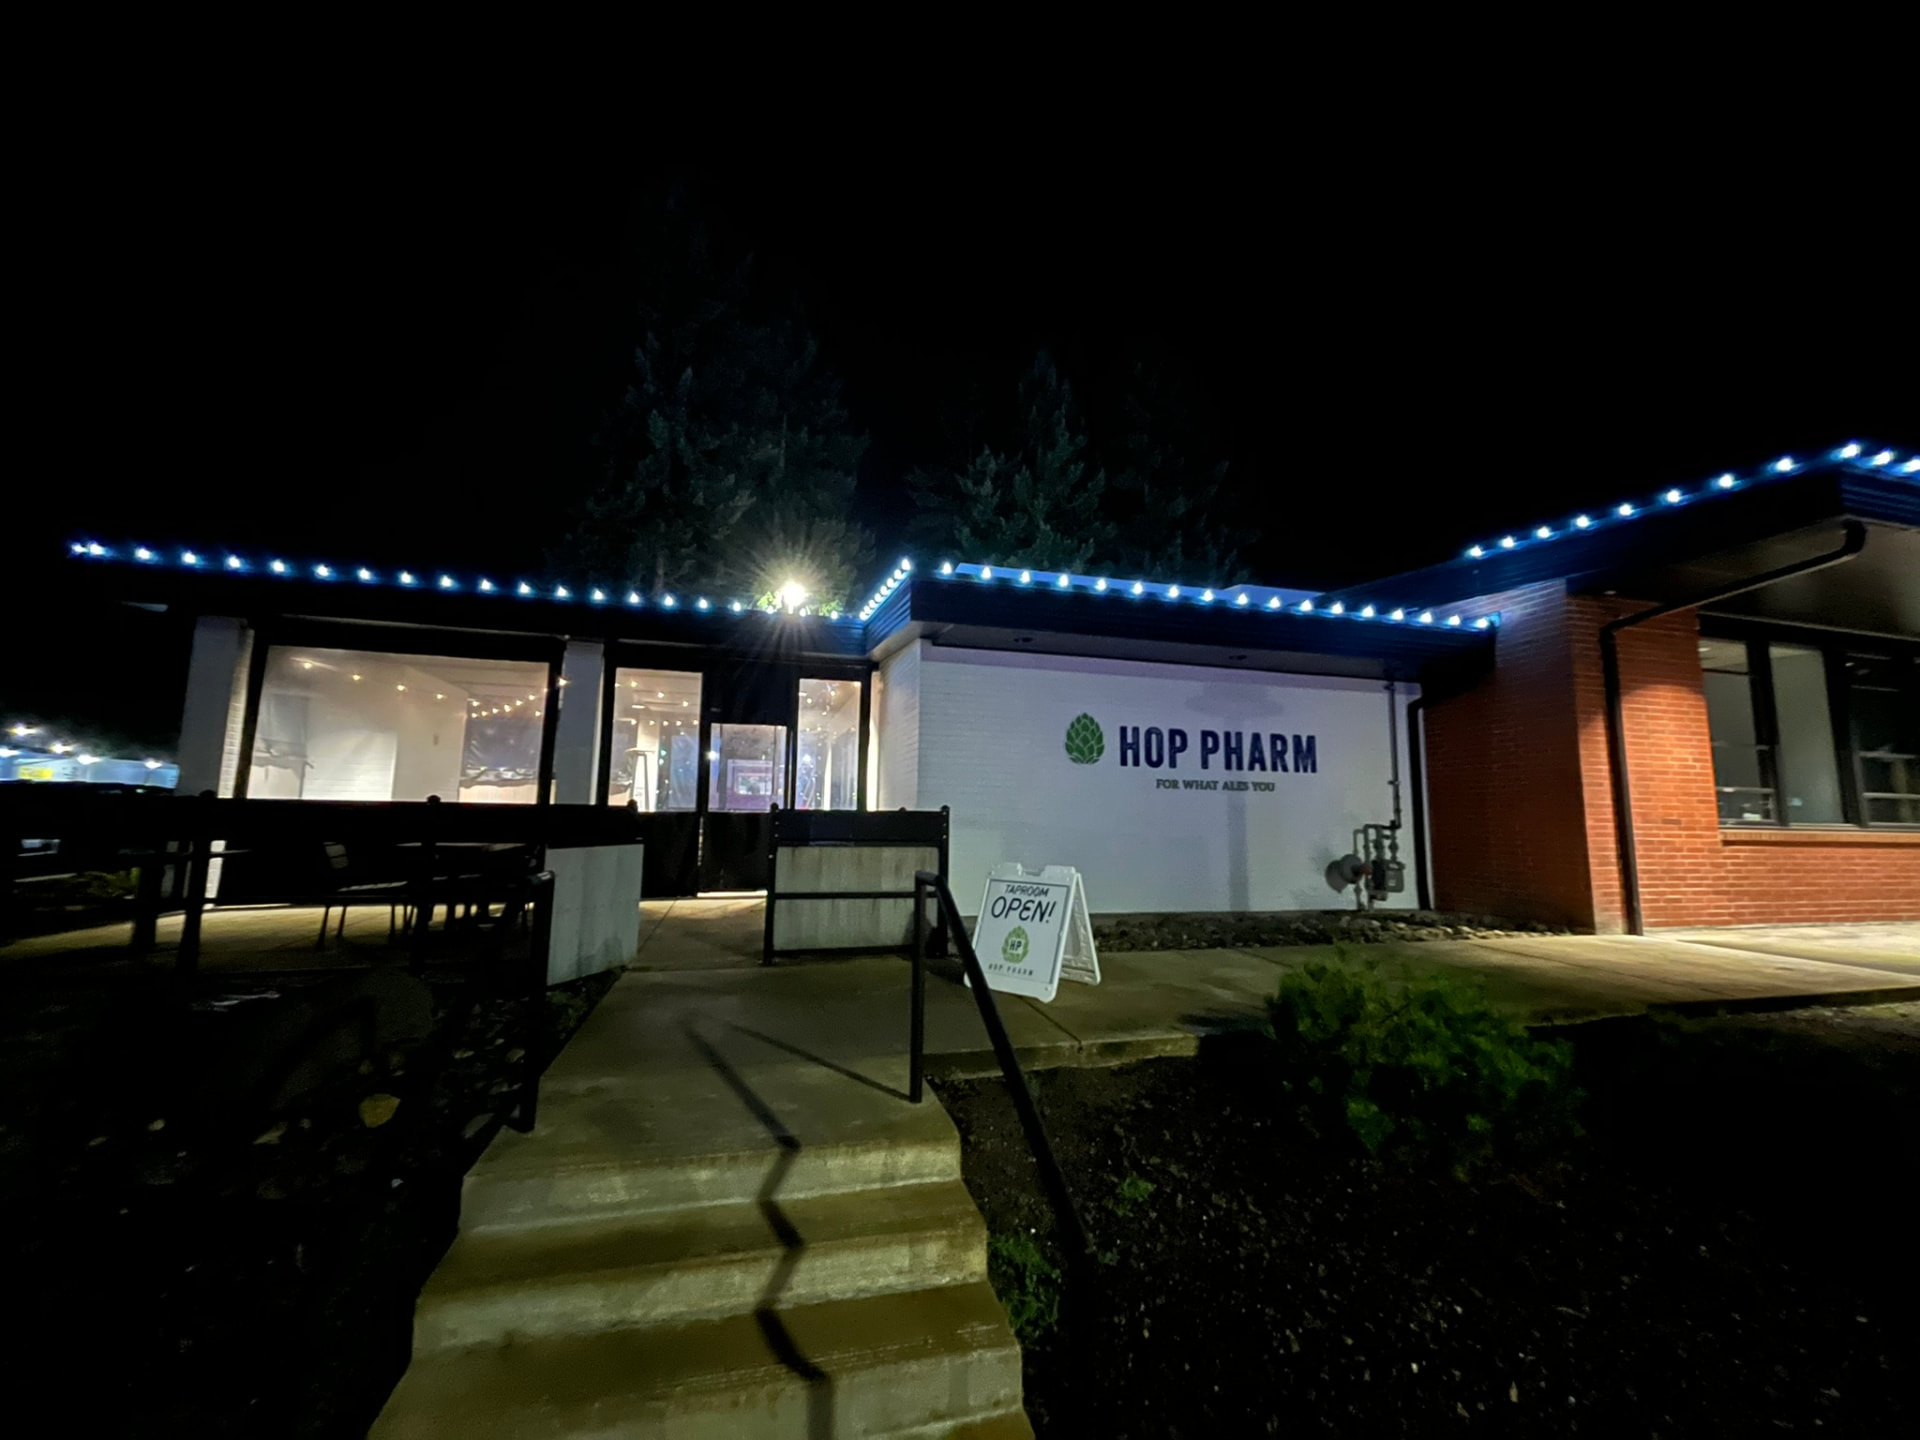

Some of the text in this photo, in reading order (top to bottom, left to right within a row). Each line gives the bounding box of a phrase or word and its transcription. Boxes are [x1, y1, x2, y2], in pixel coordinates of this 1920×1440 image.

[1119, 726, 1318, 774] HOP PHARM
[1156, 778, 1276, 792] FOR WHAT ALES YOU
[1005, 884, 1050, 898] TAPROOM
[991, 896, 1057, 924] OPEN!
[1009, 940, 1023, 952] HP
